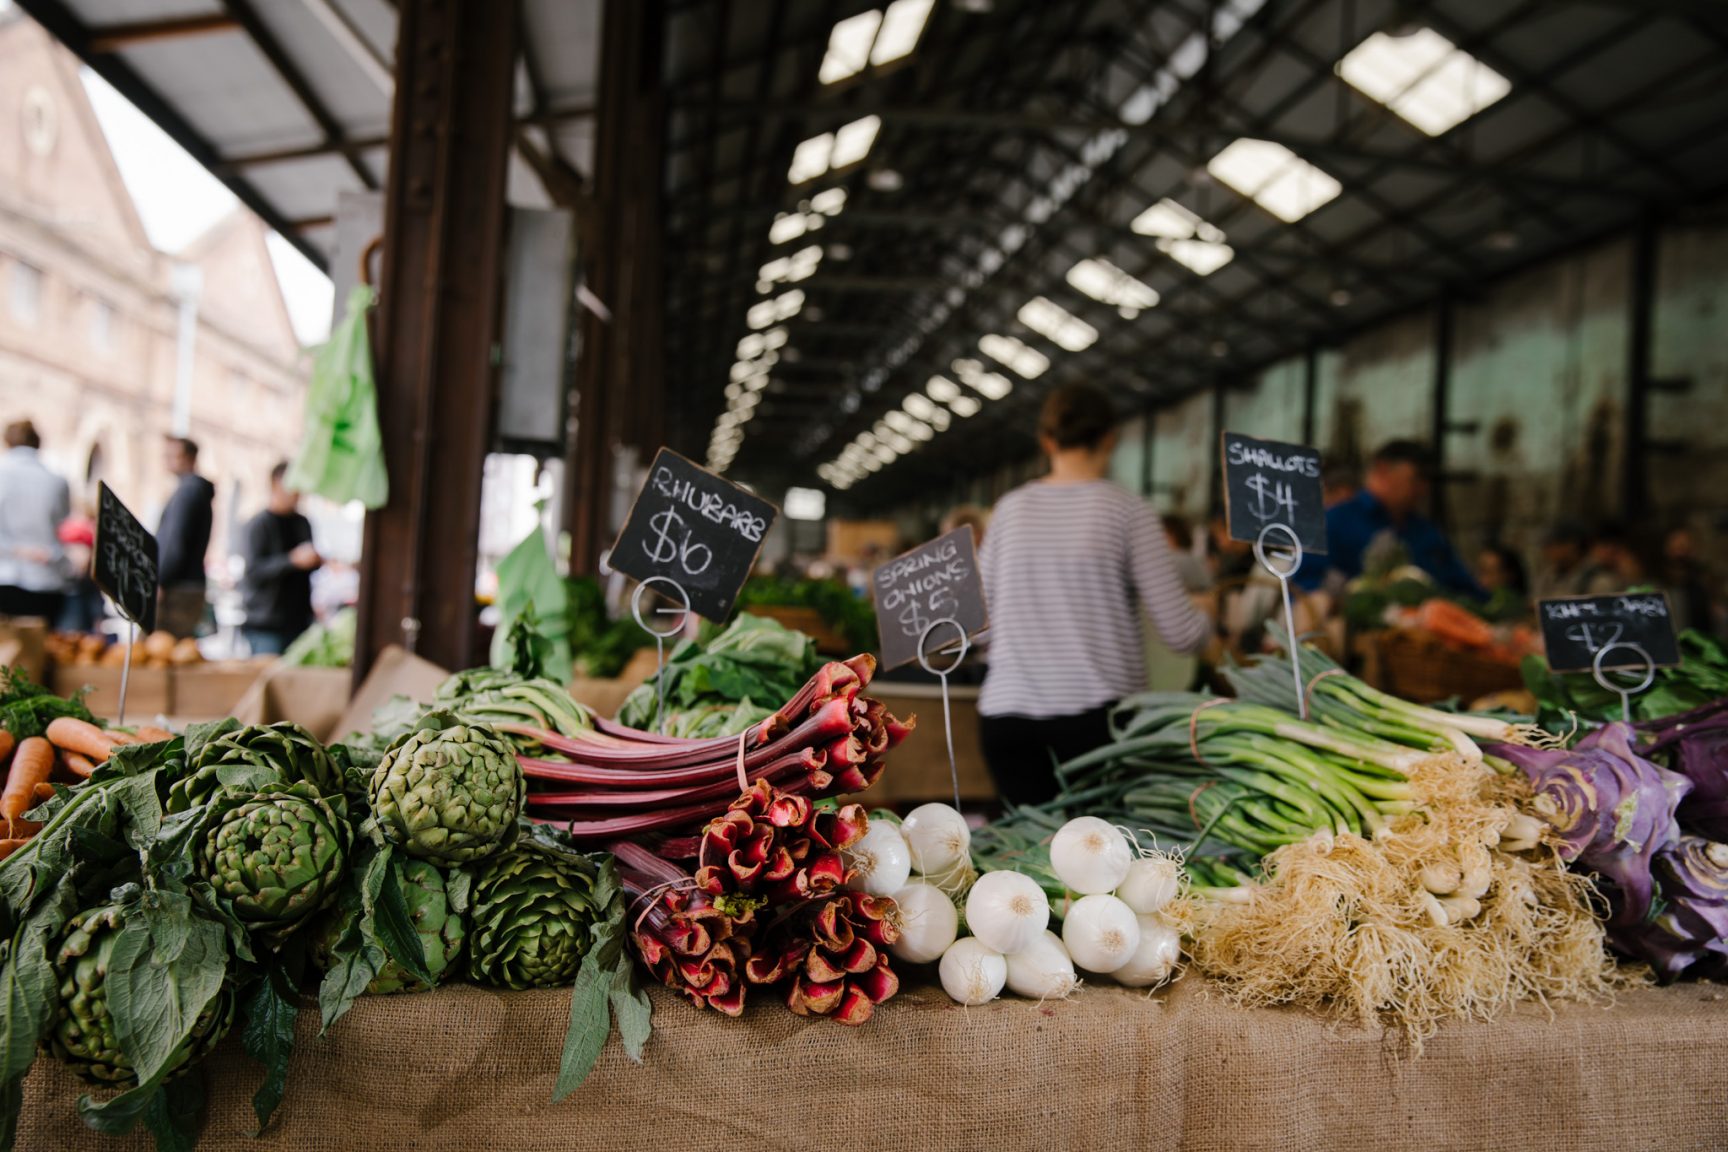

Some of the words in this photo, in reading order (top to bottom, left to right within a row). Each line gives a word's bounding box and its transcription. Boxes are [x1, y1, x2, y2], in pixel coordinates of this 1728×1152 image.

[1229, 442, 1320, 478] SHALLOTS
[653, 467, 766, 542] RHUBARB
[1245, 472, 1299, 528] $4
[642, 505, 712, 575] $6
[878, 540, 957, 588] SPRING
[883, 558, 970, 610] ONIONS
[899, 586, 959, 637] $5
